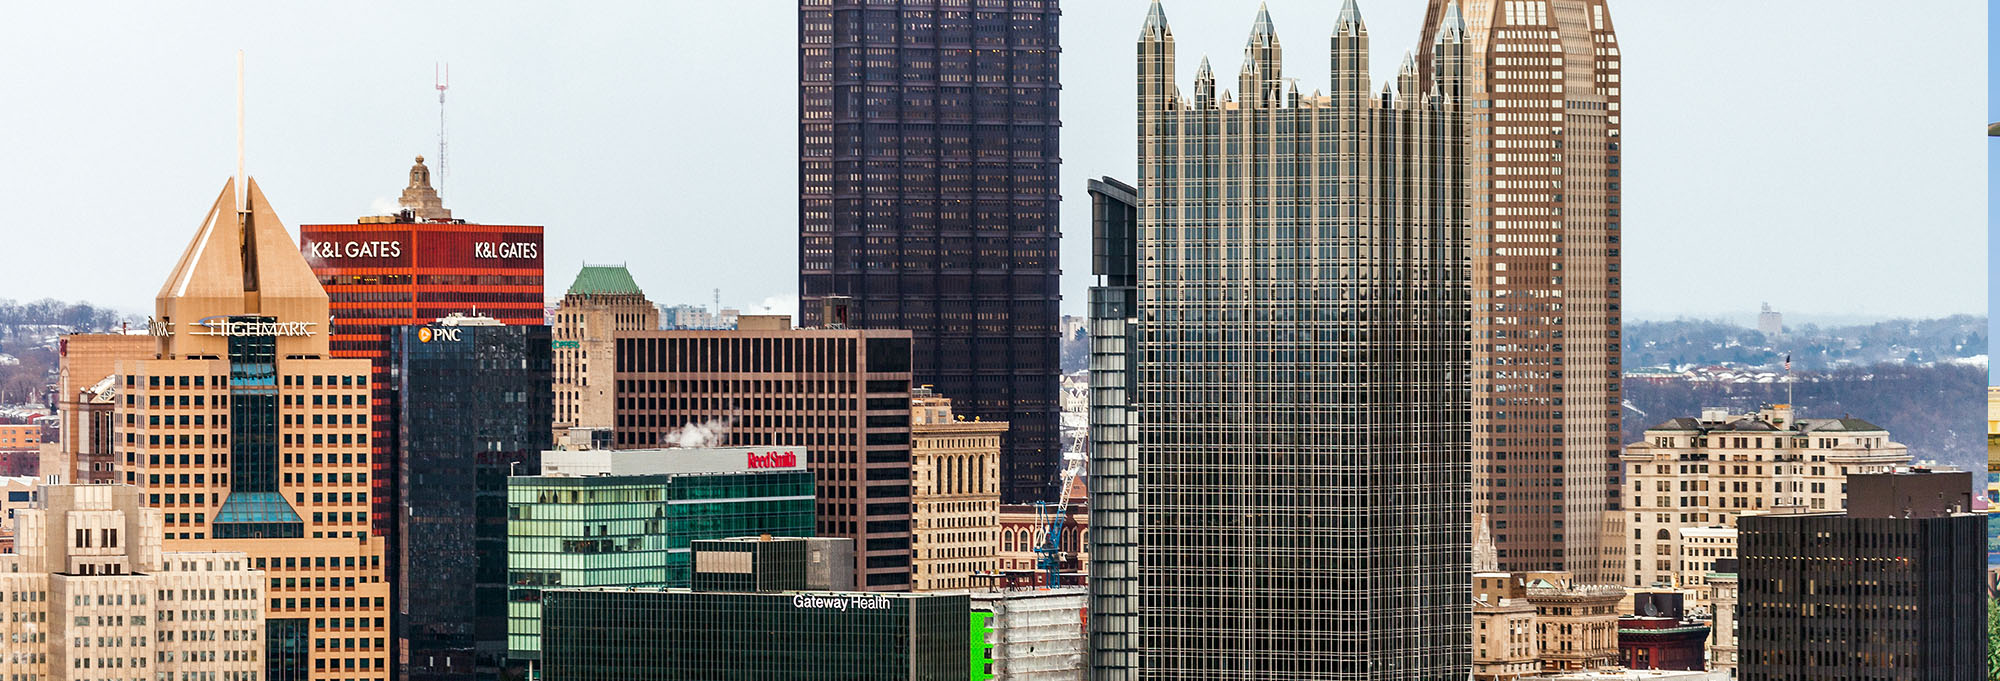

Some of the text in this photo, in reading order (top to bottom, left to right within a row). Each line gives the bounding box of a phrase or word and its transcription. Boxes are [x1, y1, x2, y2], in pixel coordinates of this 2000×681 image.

[311, 241, 401, 258] K&L GATES
[475, 241, 538, 259] K&L GATES
[210, 319, 311, 337] HIGHMARK
[433, 328, 462, 342] PNC
[747, 450, 797, 469] Reed Smith
[793, 594, 891, 612] Gateway Health
